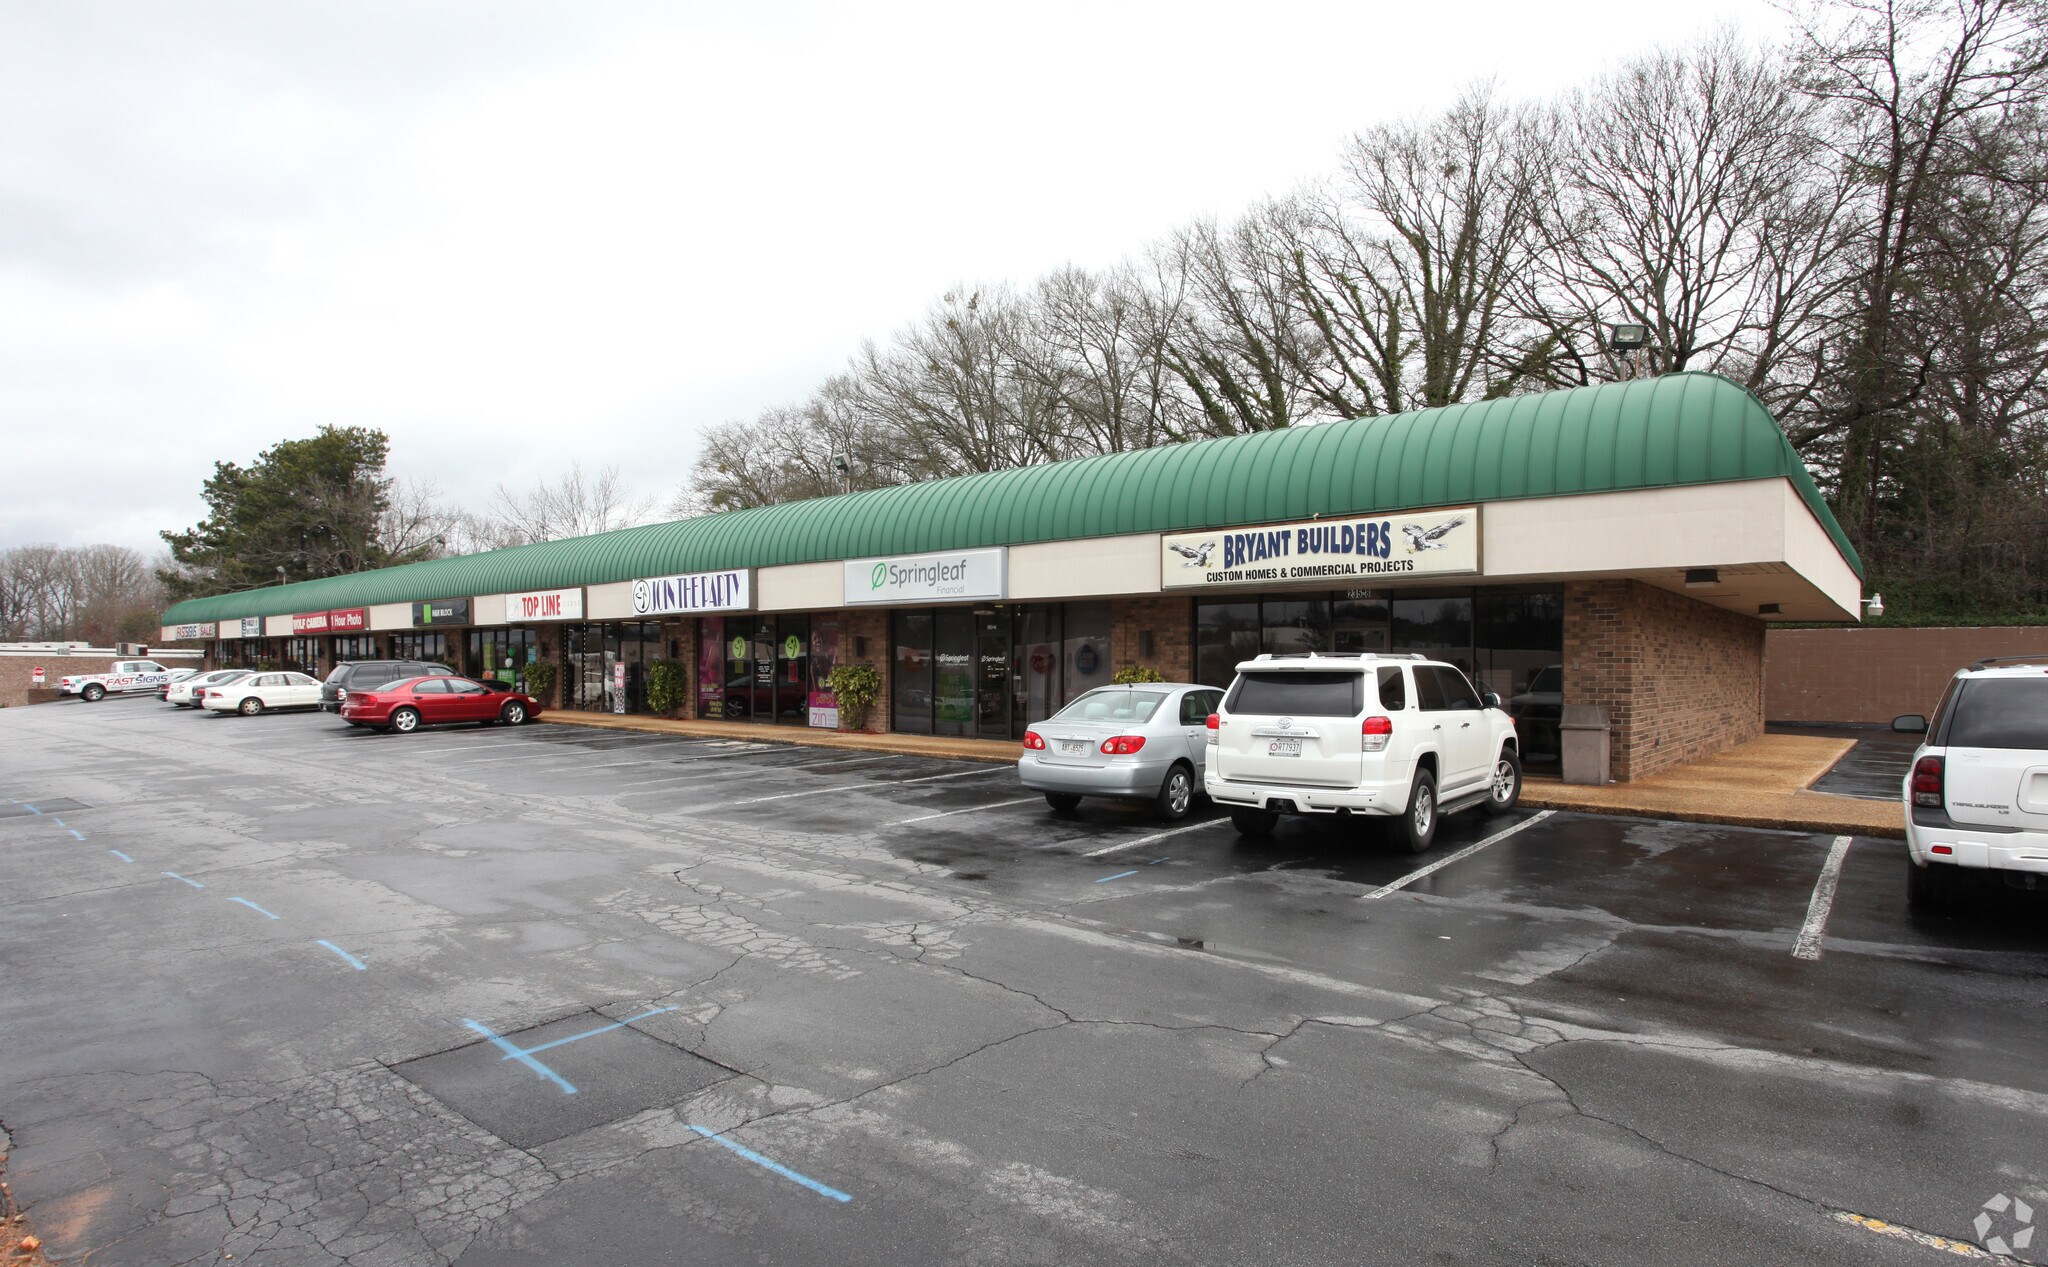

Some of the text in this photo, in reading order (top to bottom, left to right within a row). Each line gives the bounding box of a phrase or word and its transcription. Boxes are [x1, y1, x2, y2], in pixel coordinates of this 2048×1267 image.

[1224, 521, 1391, 569] BRYANT BUILDERS
[889, 559, 966, 588] Springleaf
[1206, 559, 1414, 582] CUSTOM HOMES & COMMERCIAL PROJECTS
[652, 572, 741, 611] JOIN THE PARTY
[936, 585, 965, 595] Financial
[440, 608, 453, 617] BLOCK
[522, 596, 539, 617] TOP
[541, 594, 561, 616] LINE
[306, 616, 328, 629] CAMERA
[334, 614, 346, 626] Hour
[347, 612, 362, 625] Photo
[106, 674, 168, 687] FASTSIGNS
[1278, 743, 1300, 752] RT7937
